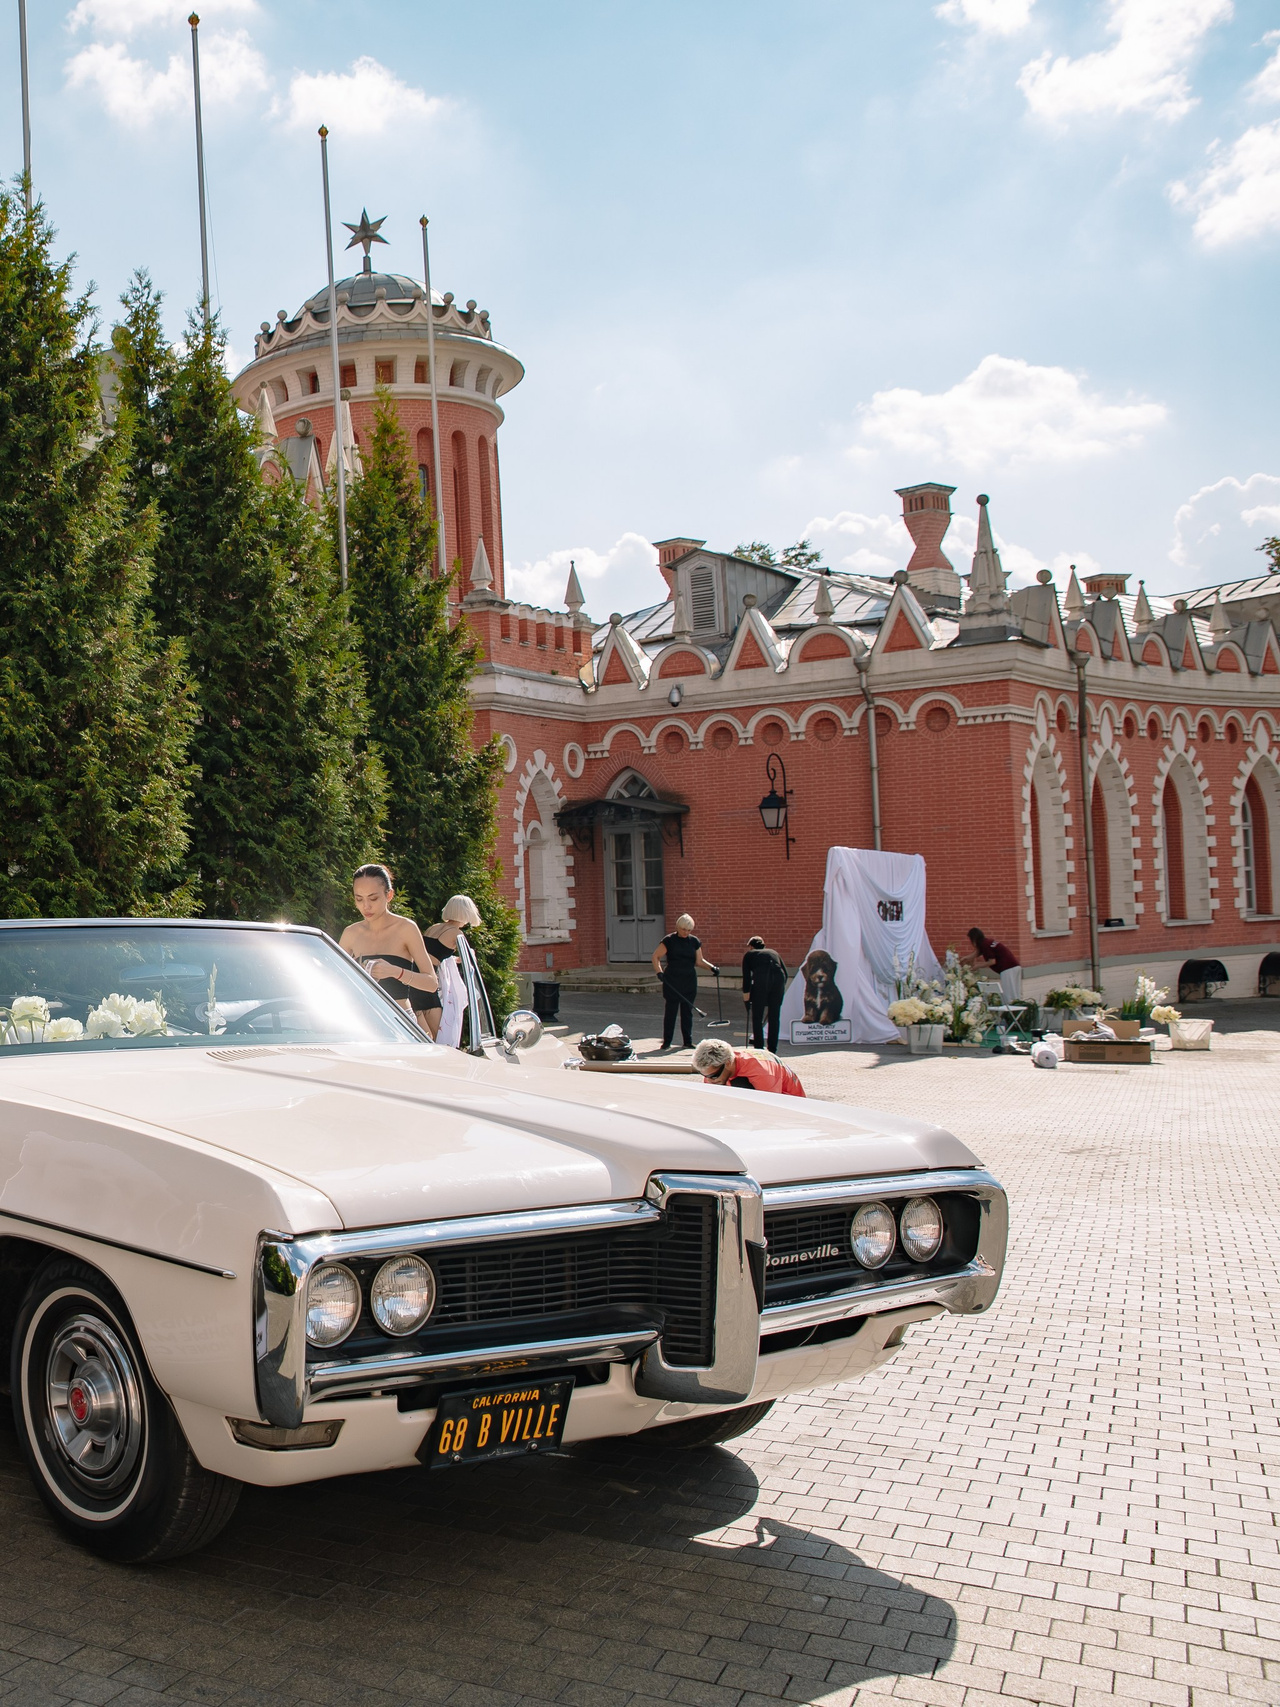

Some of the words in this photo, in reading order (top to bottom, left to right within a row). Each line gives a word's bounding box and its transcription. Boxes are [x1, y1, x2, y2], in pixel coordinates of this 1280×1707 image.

[472, 1389, 540, 1410] CALIFORNIA
[438, 1417, 469, 1454] 68
[476, 1413, 492, 1448] B
[500, 1403, 561, 1443] VILLE
